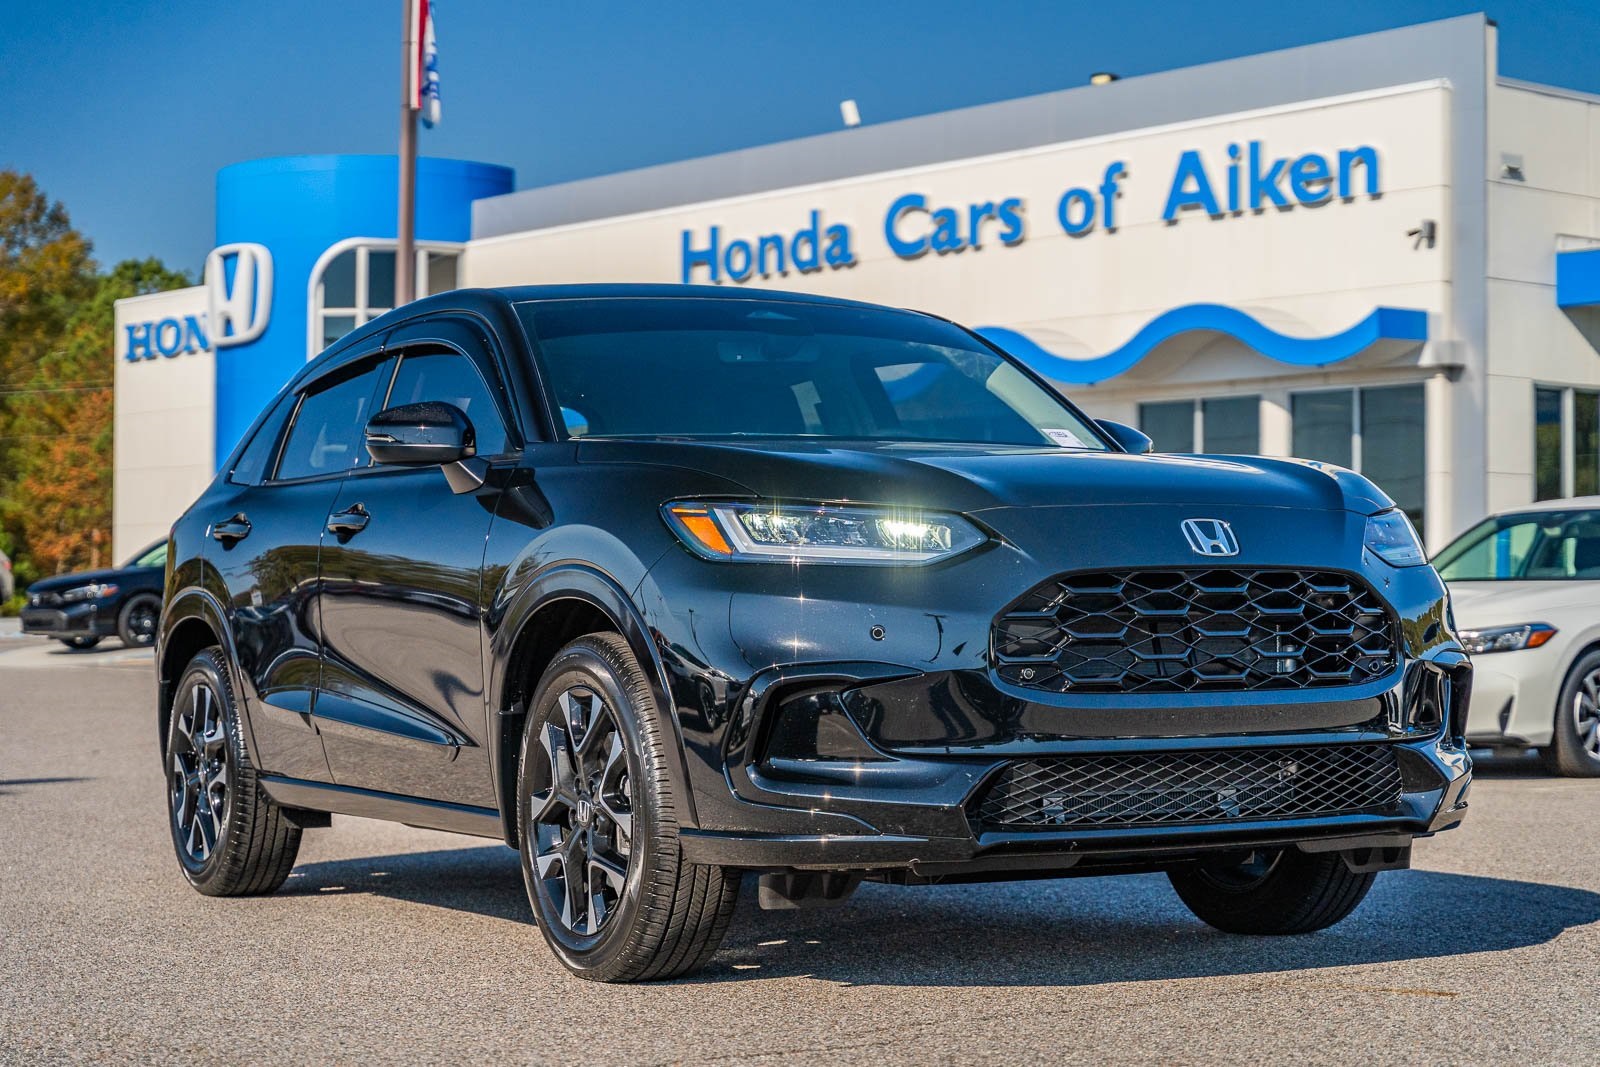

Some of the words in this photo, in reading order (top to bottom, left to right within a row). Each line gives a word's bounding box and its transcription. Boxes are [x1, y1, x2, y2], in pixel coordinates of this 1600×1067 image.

[681, 208, 855, 284] Honda
[884, 193, 1025, 258] Cars
[1057, 160, 1127, 235] of
[1161, 140, 1380, 221] Aiken
